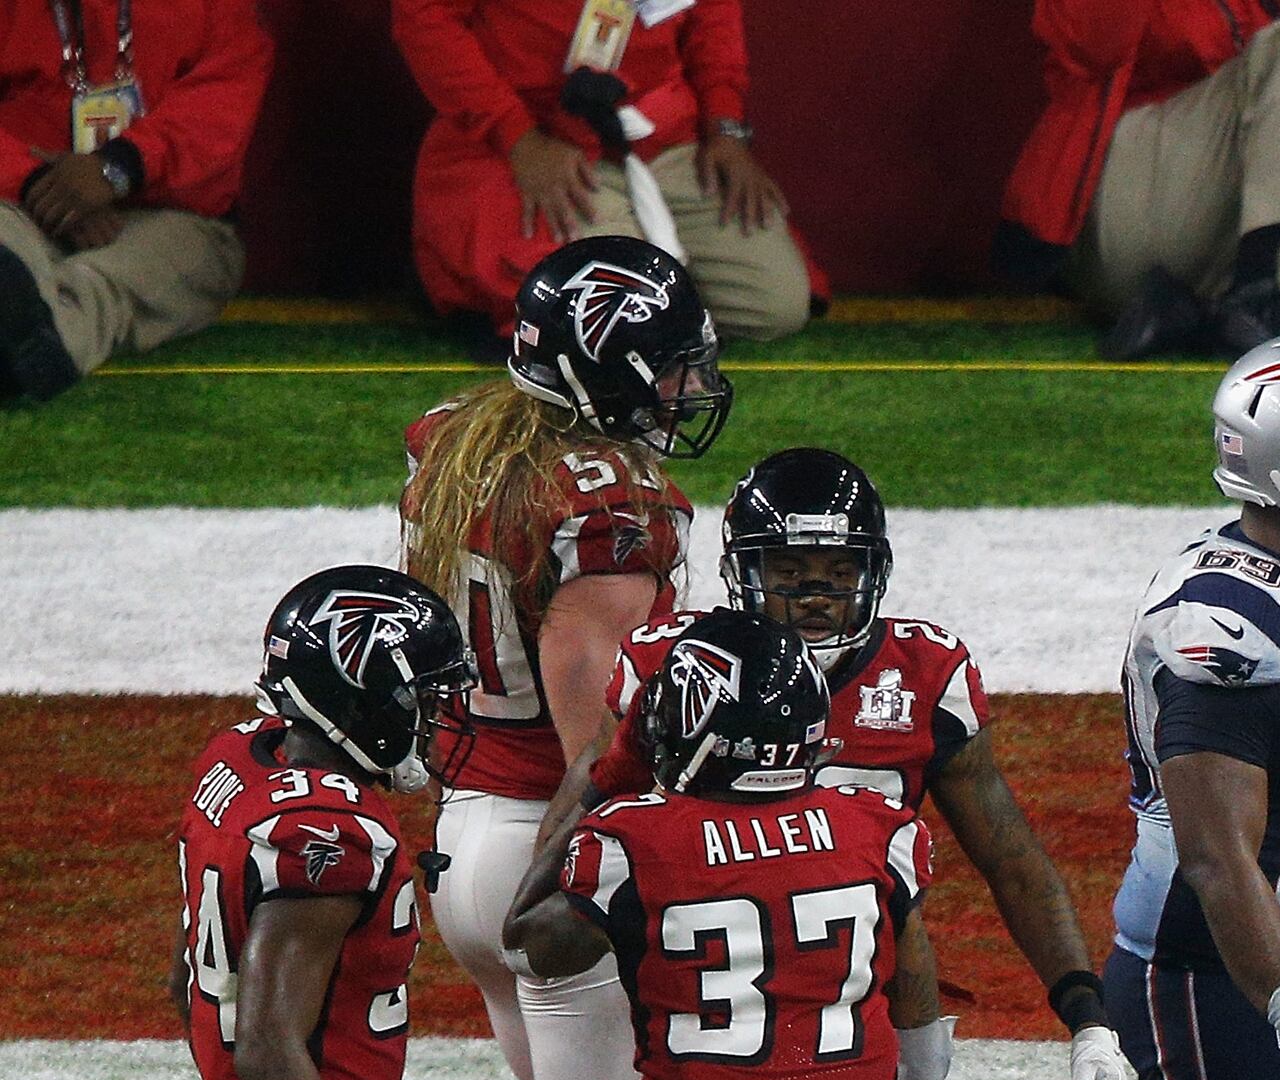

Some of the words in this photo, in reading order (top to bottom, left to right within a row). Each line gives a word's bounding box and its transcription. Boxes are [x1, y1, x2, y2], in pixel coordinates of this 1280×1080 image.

[760, 743, 800, 767] 37
[267, 768, 360, 804] 34
[702, 808, 835, 866] ALLEN
[661, 883, 881, 1058] 37
